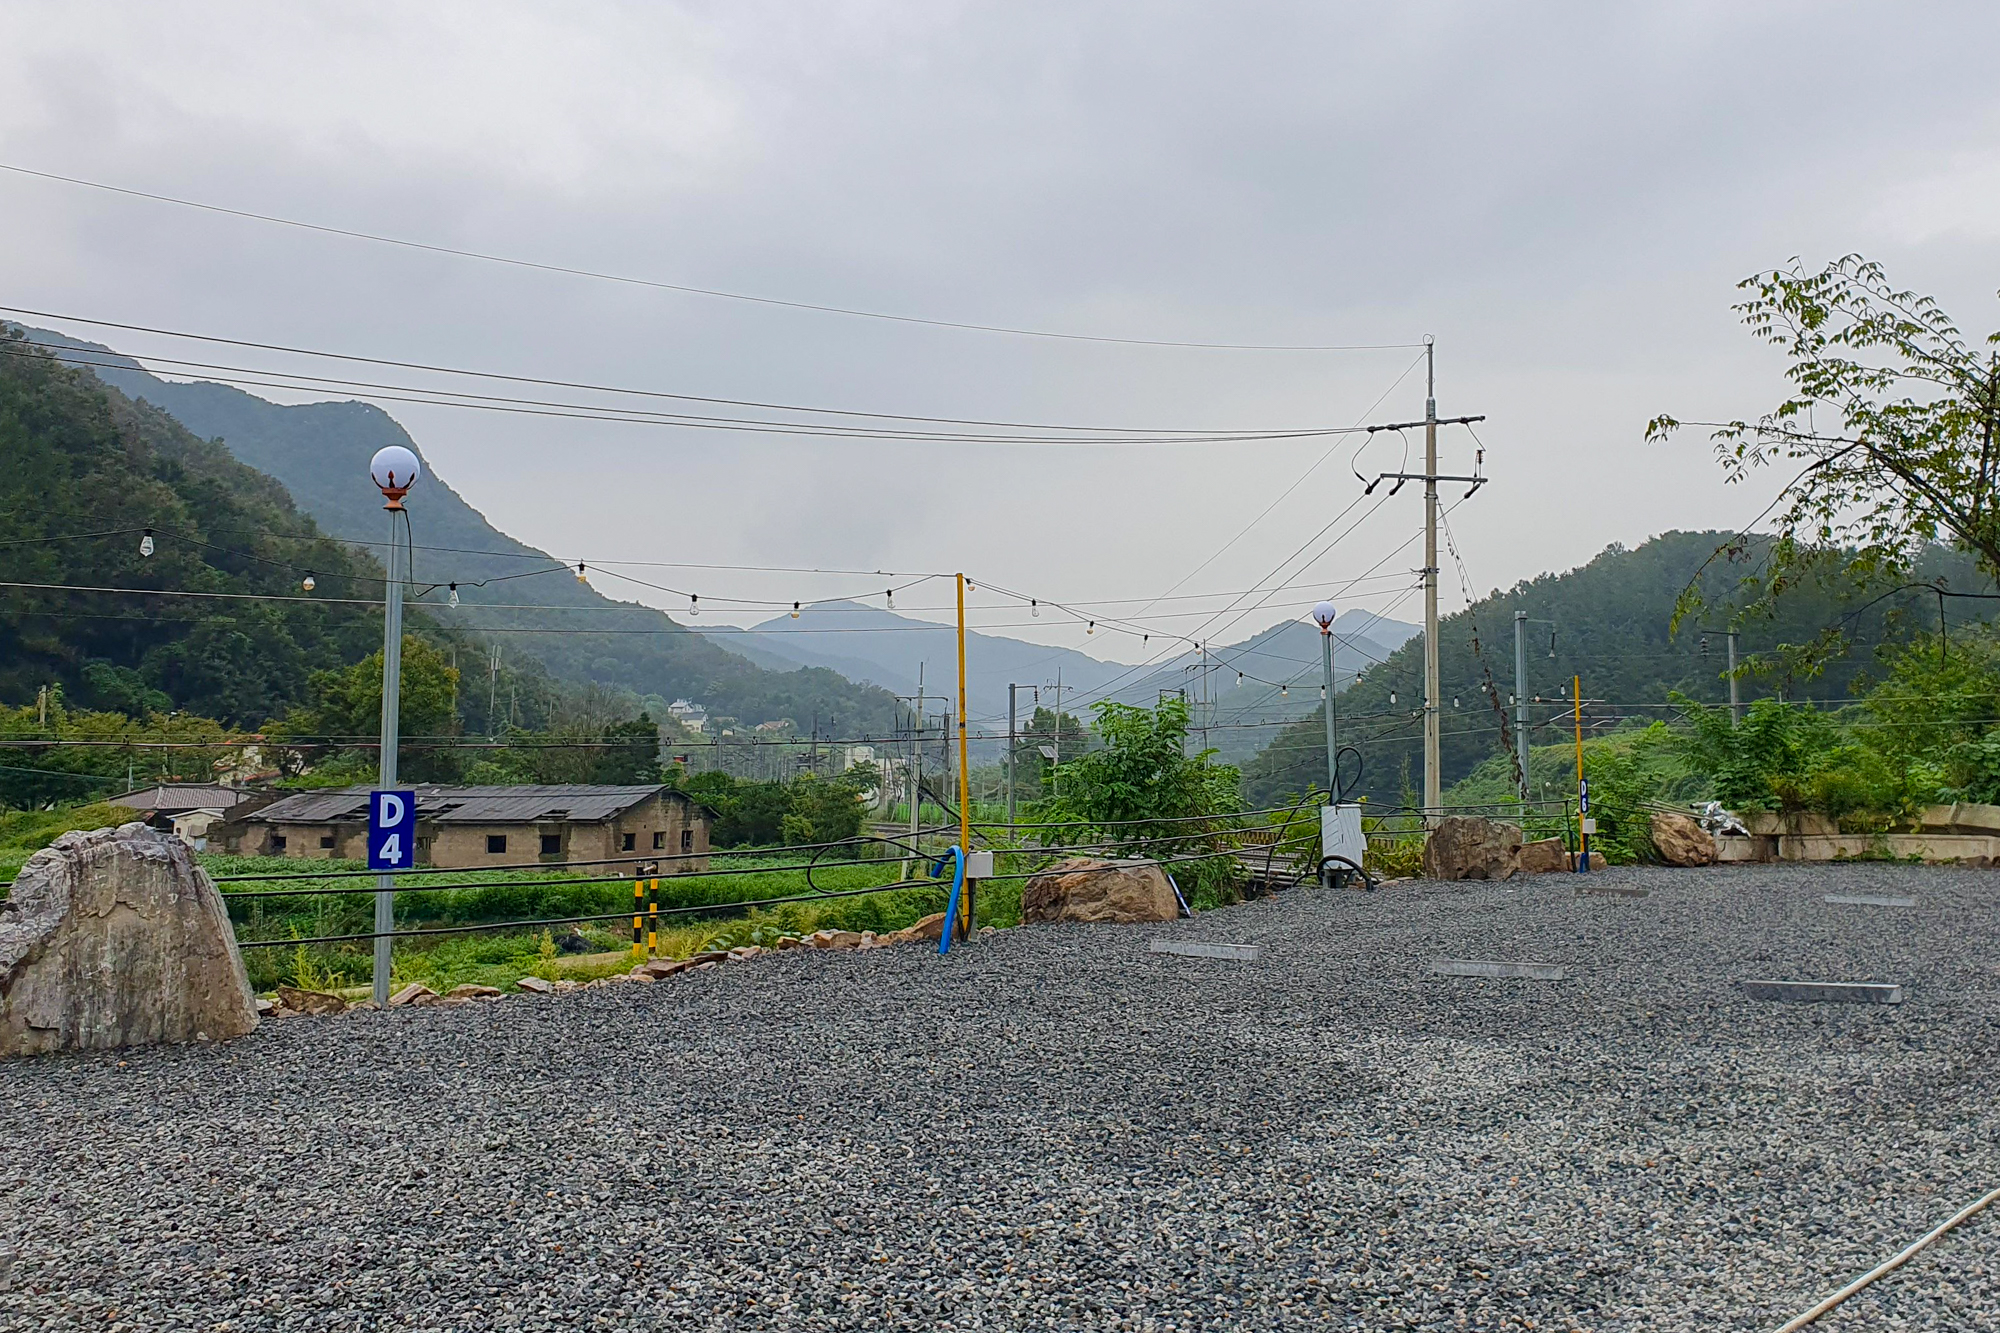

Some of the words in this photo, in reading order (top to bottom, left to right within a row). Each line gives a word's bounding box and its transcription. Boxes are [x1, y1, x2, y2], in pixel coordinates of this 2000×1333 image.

[1580, 780, 1588, 796] D
[380, 794, 405, 828] D
[1581, 797, 1588, 812] 6
[379, 833, 403, 865] 4
